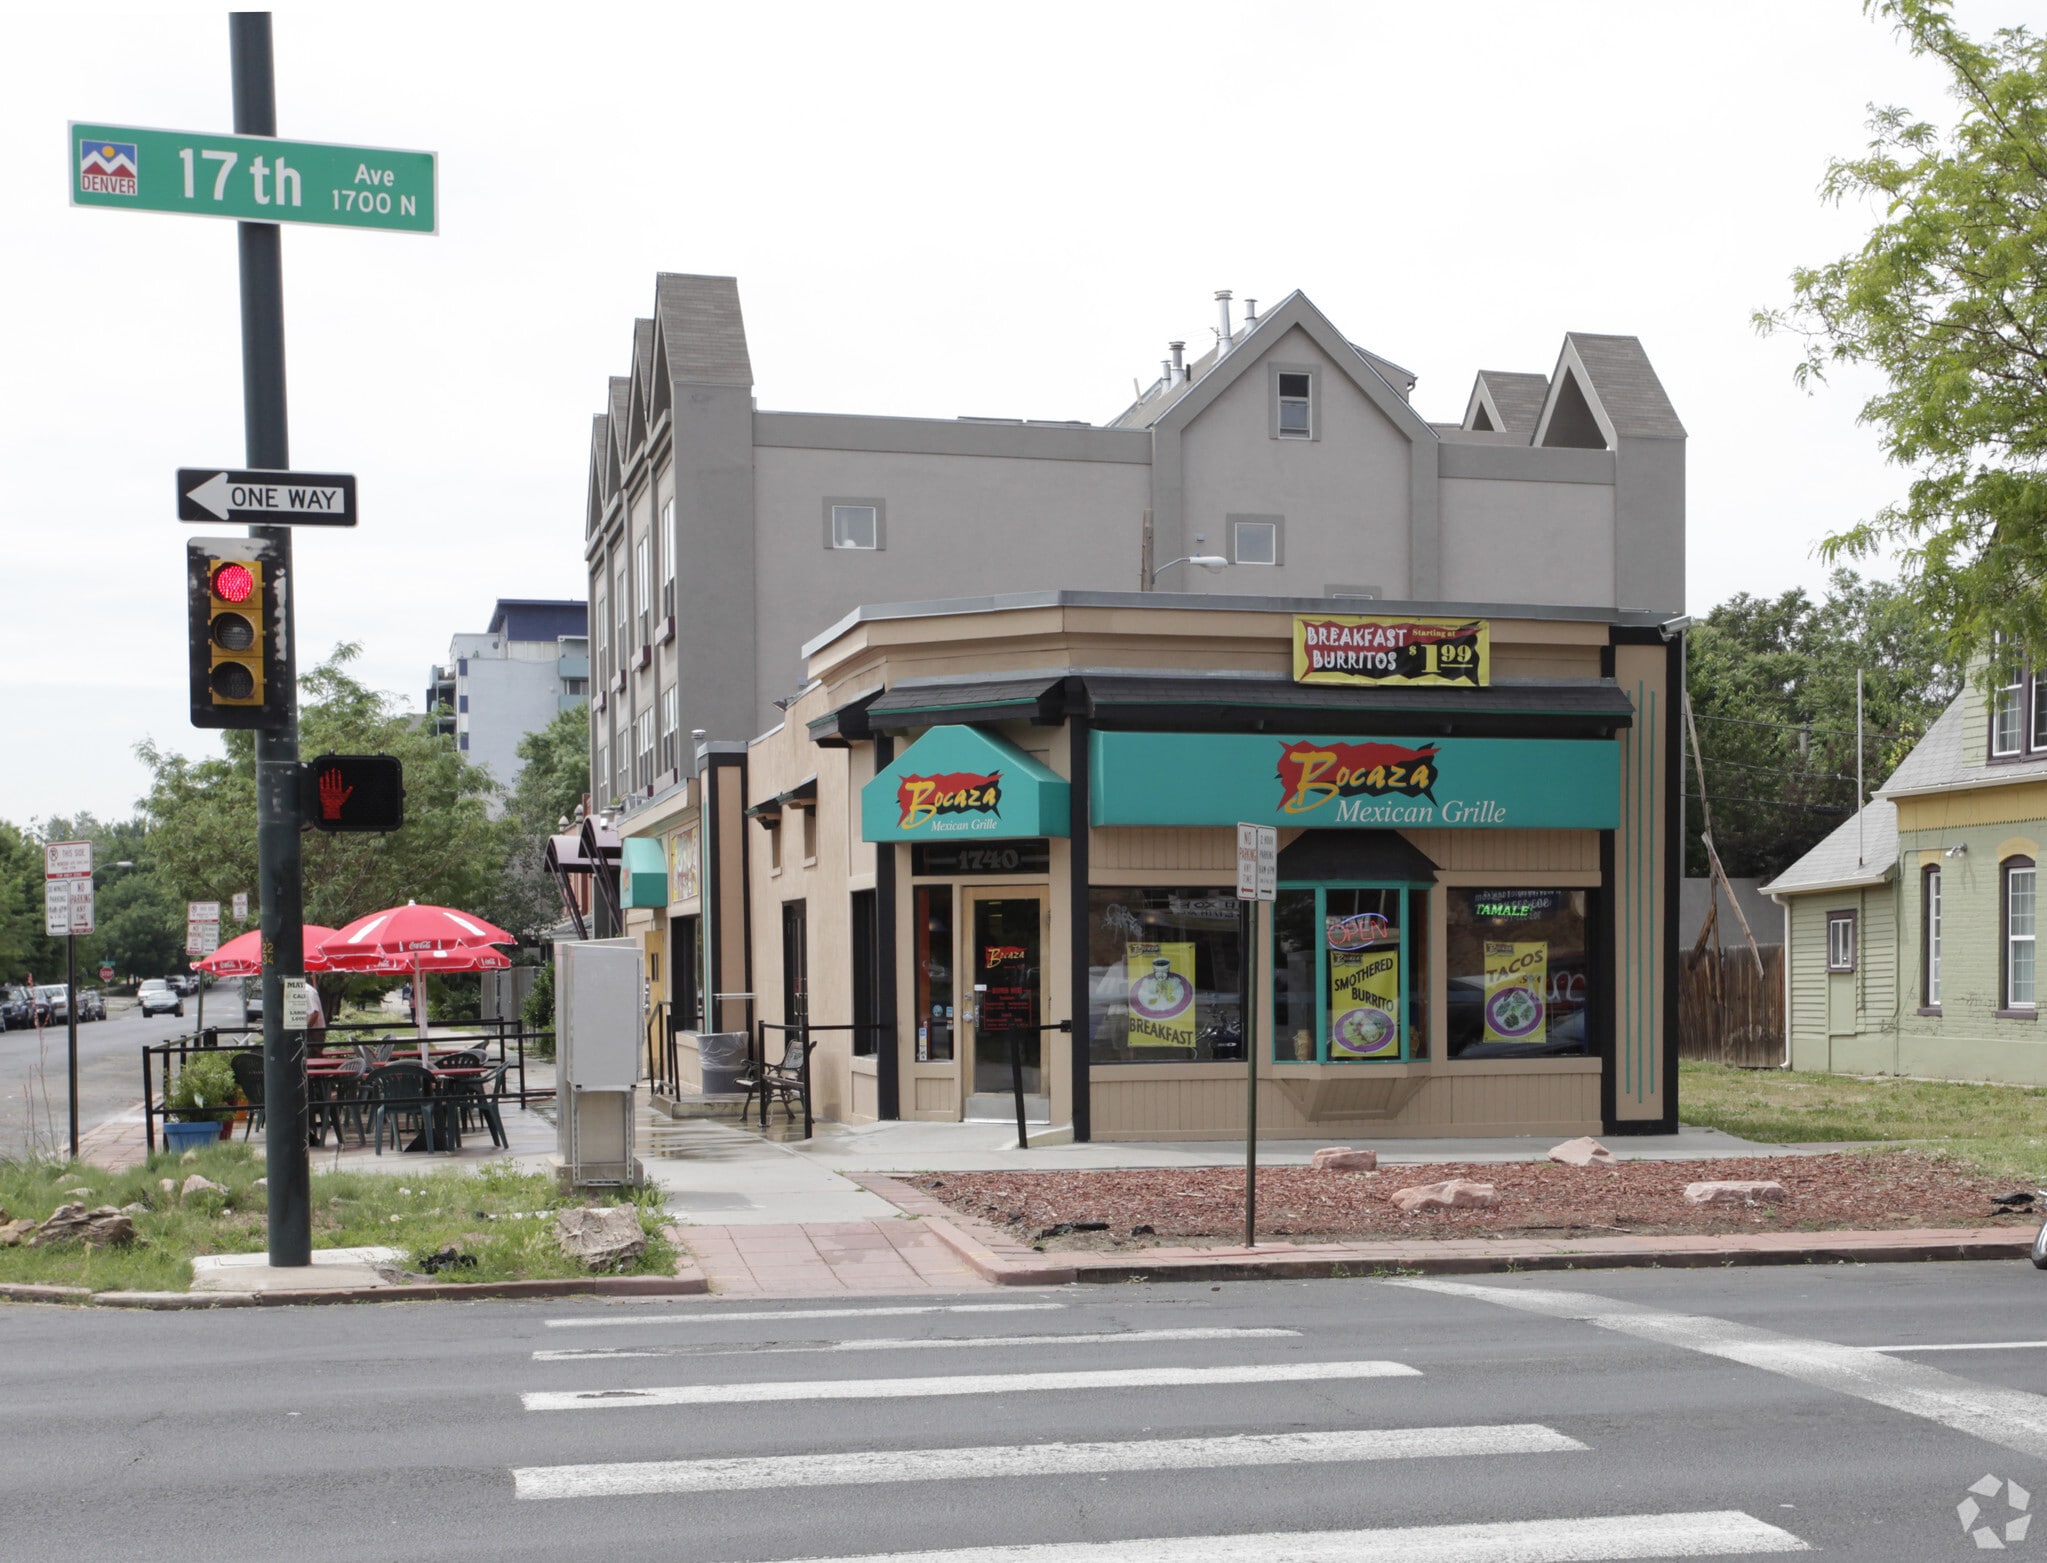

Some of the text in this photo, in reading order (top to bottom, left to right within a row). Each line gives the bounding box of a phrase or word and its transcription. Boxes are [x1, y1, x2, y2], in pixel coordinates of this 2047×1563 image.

[81, 175, 137, 194] DENVER
[179, 148, 302, 208] 17th
[354, 163, 395, 186] Ave
[332, 189, 416, 216] 1700 N
[231, 486, 337, 510] ONE WAY
[1306, 625, 1456, 647] BREAKFAST Starting at
[1312, 650, 1397, 670] BURRITOS
[1284, 751, 1430, 814] Bocaza
[901, 780, 997, 830] Bocaza
[1334, 799, 1507, 823] Mexican Grille
[931, 818, 998, 832] Mexican Grille
[958, 849, 1020, 869] 1740
[1476, 903, 1534, 917] TAMALE
[1327, 919, 1389, 945] OPEN
[986, 948, 1025, 969] Bocaza
[1486, 950, 1544, 984] TACOS
[1334, 958, 1394, 992] SMOTHERED
[1351, 987, 1394, 1012] BURRITO
[1129, 1017, 1194, 1046] BREAKFAST
